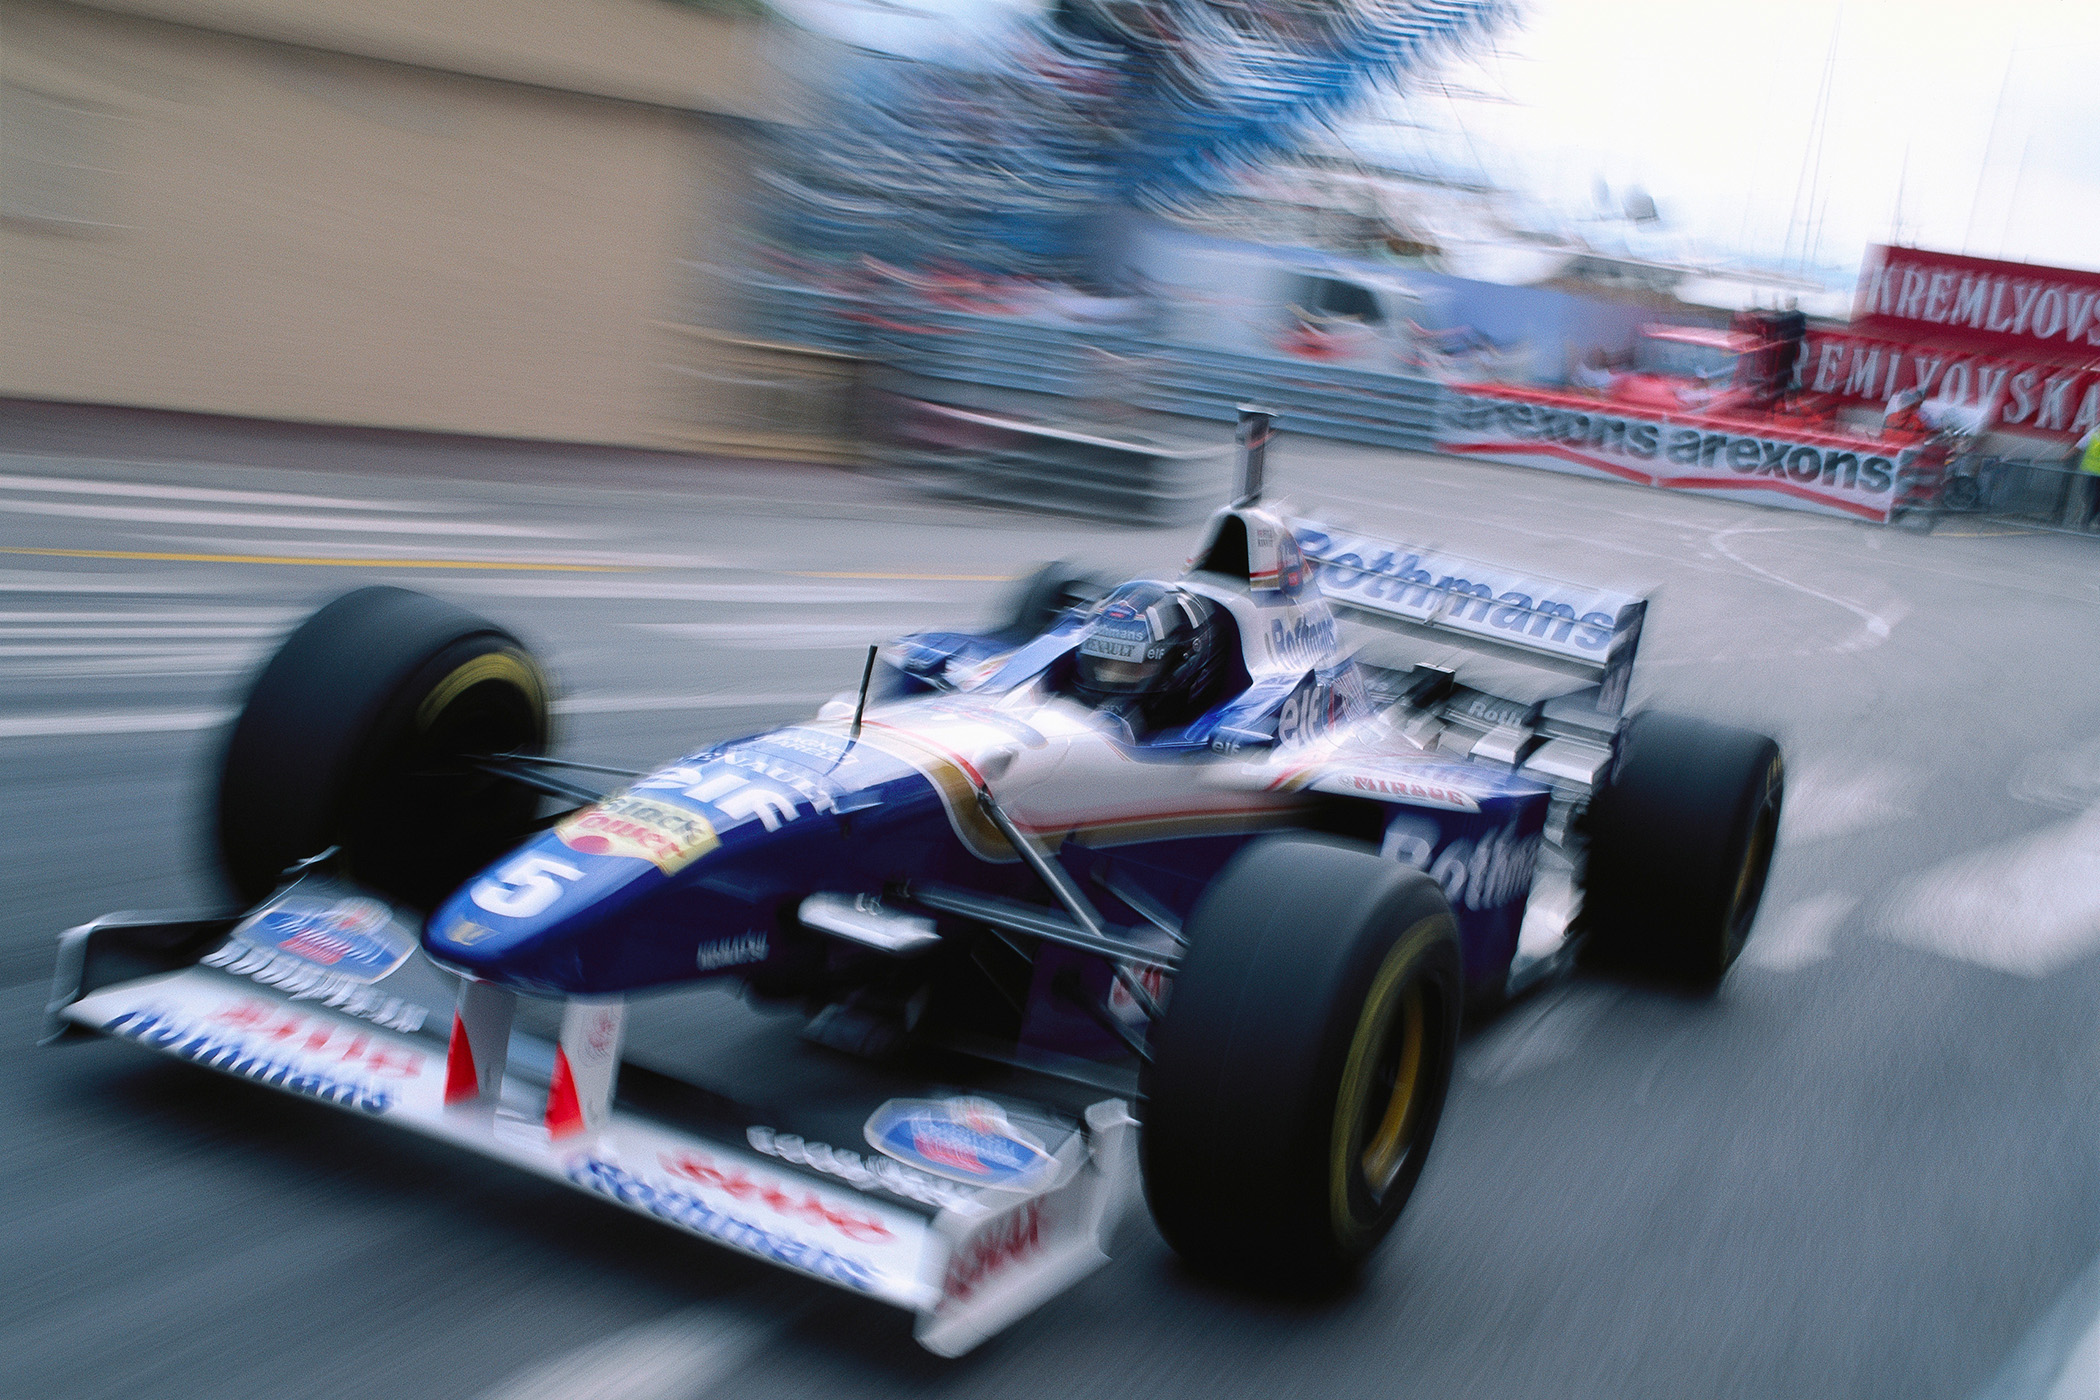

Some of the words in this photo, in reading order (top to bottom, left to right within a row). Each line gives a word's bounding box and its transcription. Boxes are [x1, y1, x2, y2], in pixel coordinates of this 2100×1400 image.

[1666, 429, 1893, 494] arexons
[1279, 686, 1325, 748] elf
[1467, 700, 1523, 729] Roth
[1211, 741, 1241, 756] elf
[470, 857, 587, 918] 5
